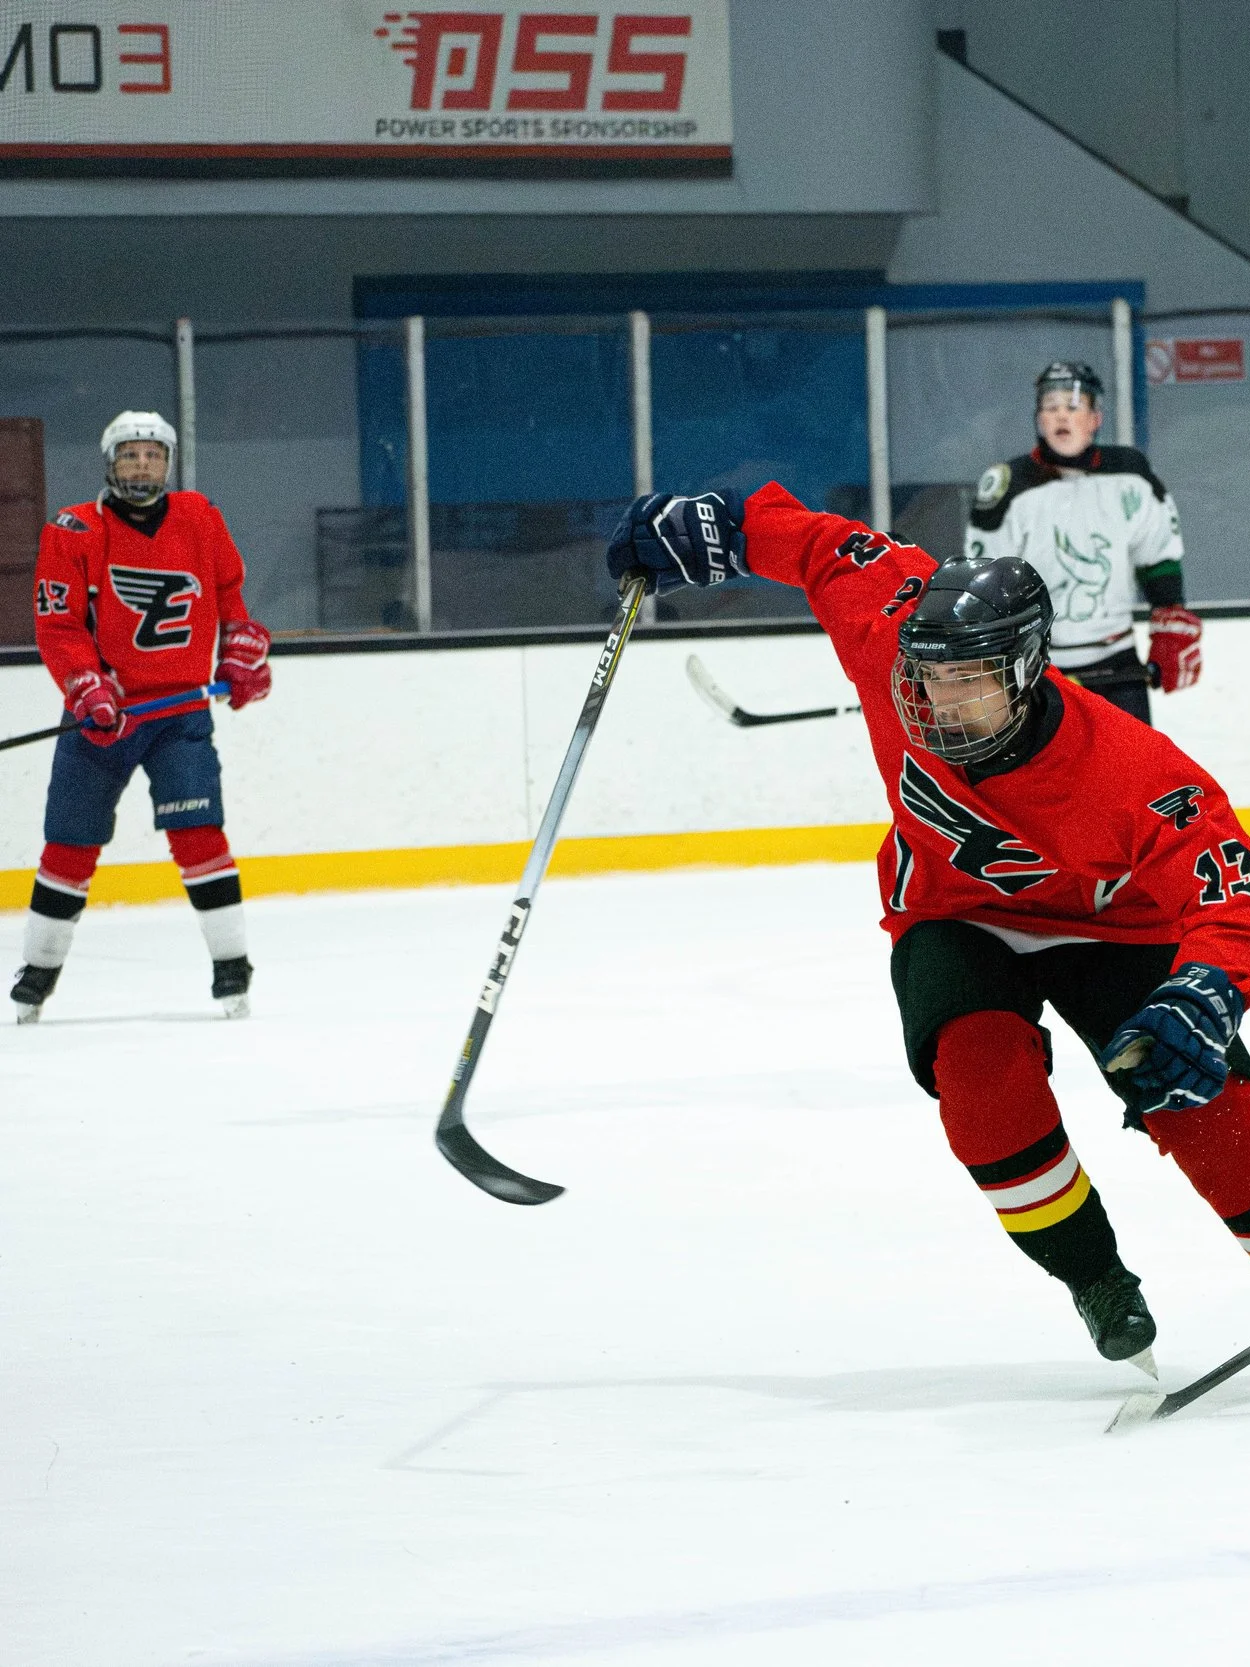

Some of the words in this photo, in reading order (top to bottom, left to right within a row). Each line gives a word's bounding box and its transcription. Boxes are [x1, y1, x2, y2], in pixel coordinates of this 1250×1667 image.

[402, 12, 693, 111] PSS
[375, 118, 455, 138] POWER
[461, 119, 545, 138] SPORTS
[551, 119, 697, 138] SPONSORSHIP
[593, 632, 620, 687] CCM
